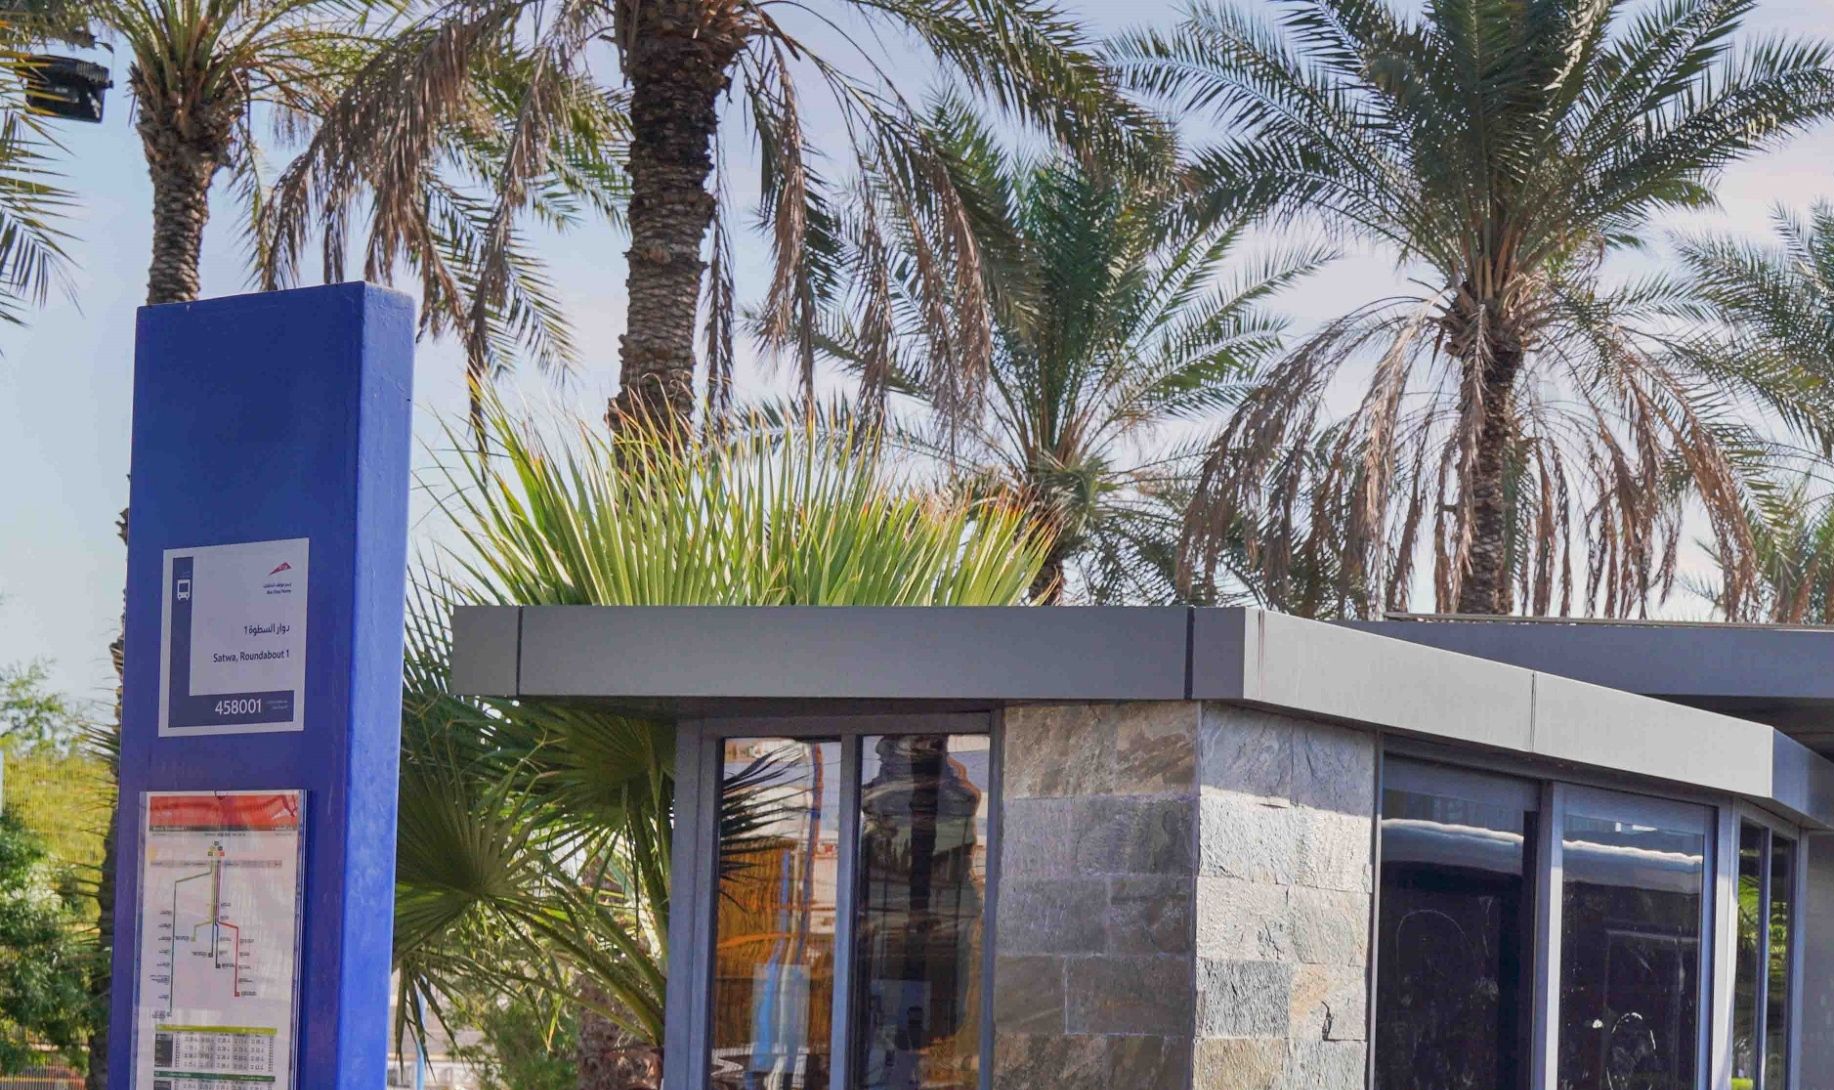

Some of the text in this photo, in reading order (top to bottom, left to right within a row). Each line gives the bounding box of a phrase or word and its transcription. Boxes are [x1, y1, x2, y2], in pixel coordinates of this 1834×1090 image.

[213, 649, 290, 663] Satwa, Roundabout 1
[214, 699, 262, 715] 458001
